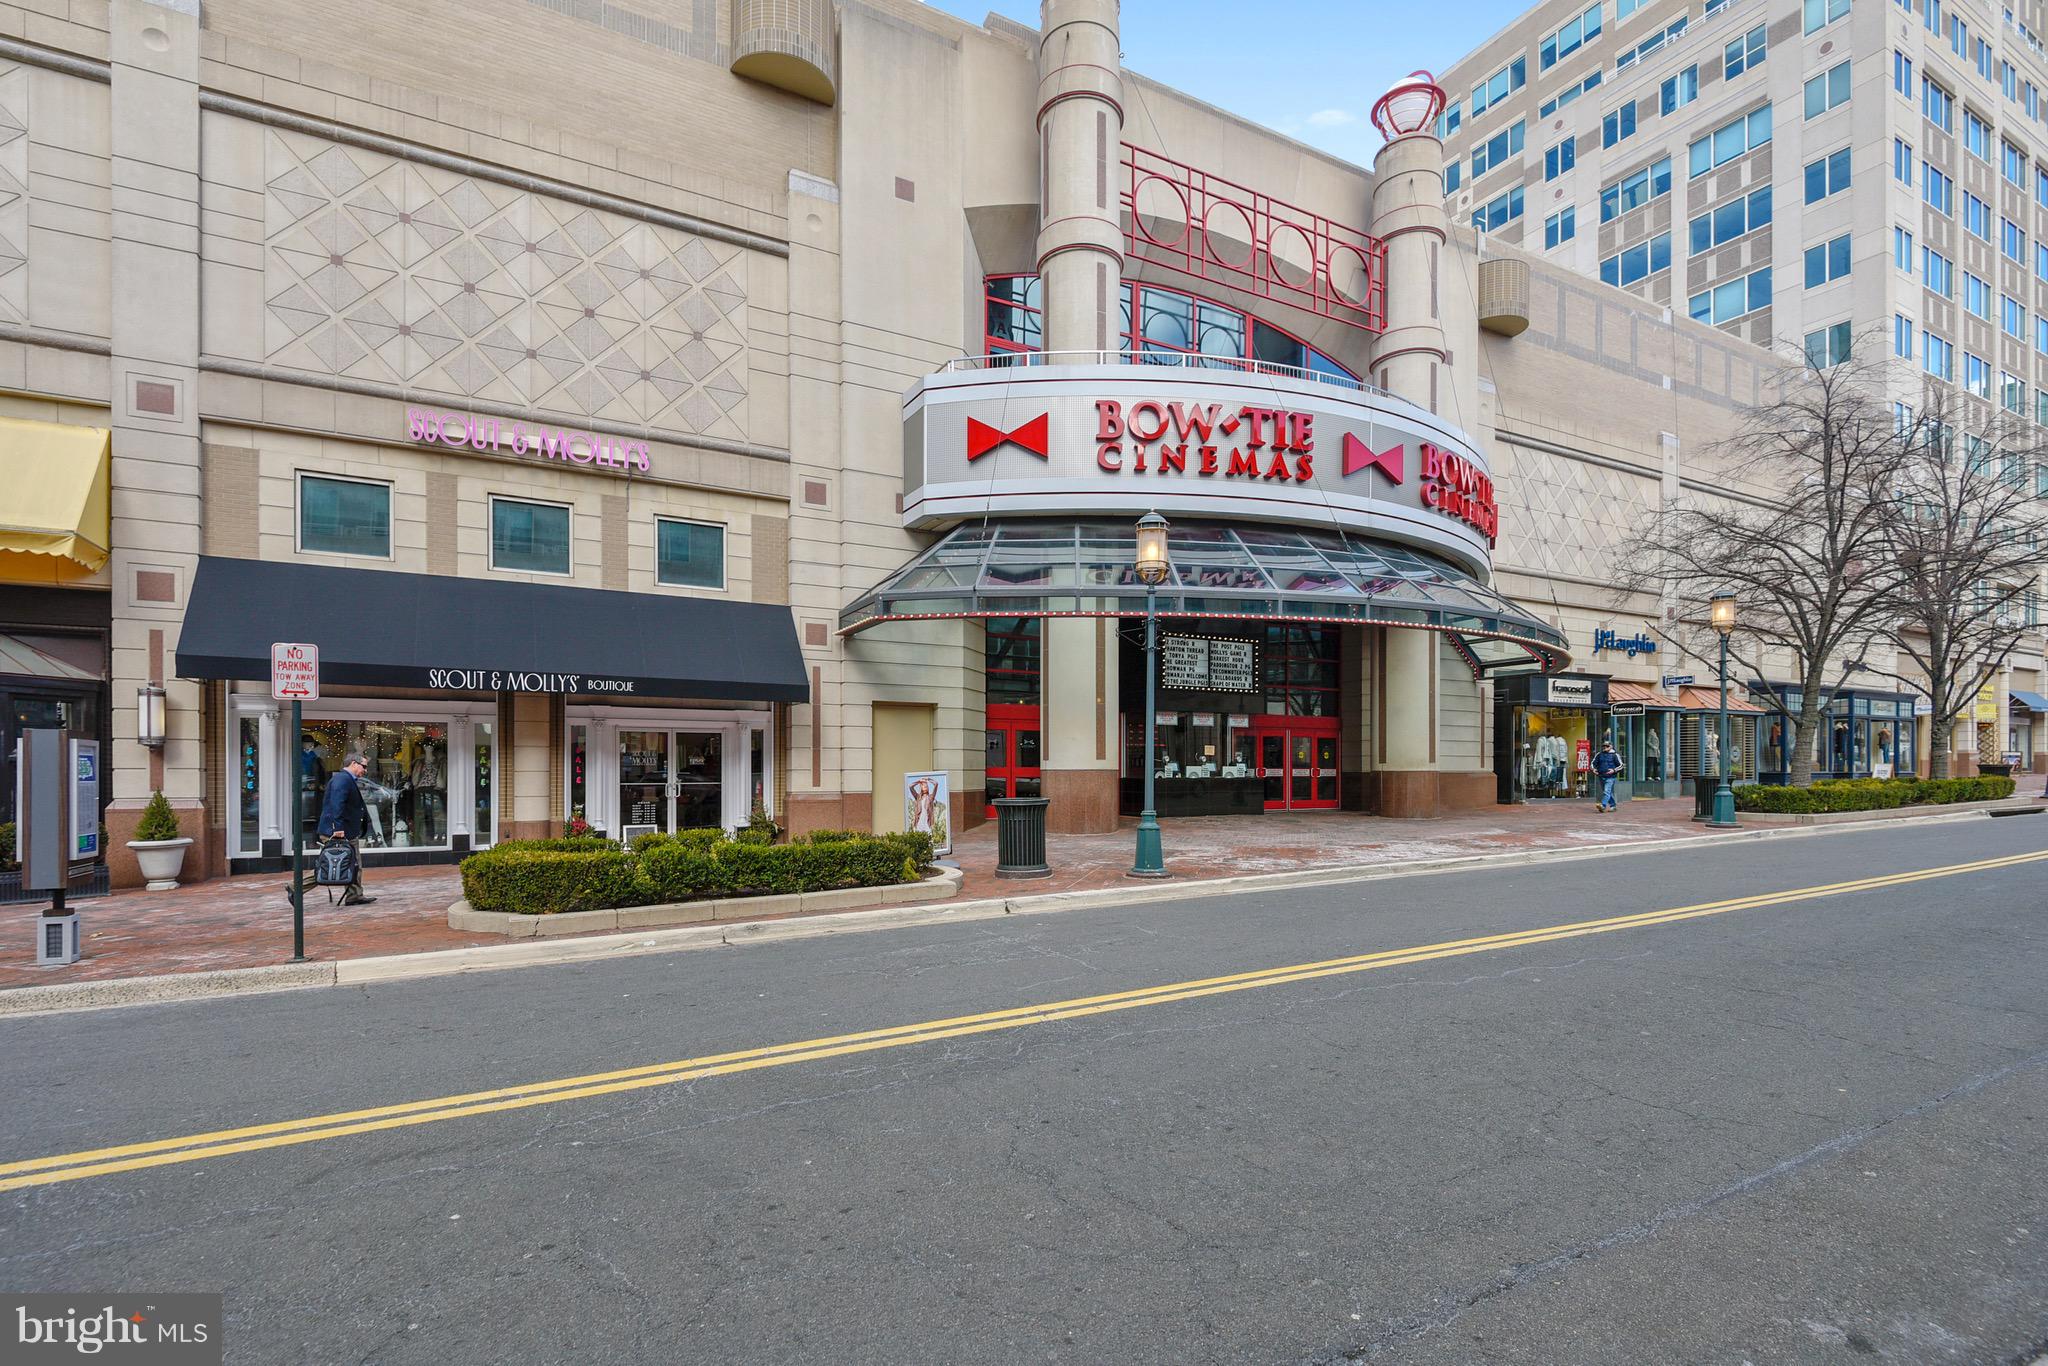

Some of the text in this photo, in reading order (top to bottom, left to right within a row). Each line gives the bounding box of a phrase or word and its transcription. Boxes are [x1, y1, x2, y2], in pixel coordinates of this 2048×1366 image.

[408, 407, 650, 471] SCOUT & MOLLY'S
[1097, 442, 1313, 482] CINEMAS
[278, 661, 312, 671] PARKING
[288, 649, 303, 659] NO
[429, 668, 634, 692] SCOUT & MOLLY'S BOUTIQUE
[246, 746, 254, 789] SALE
